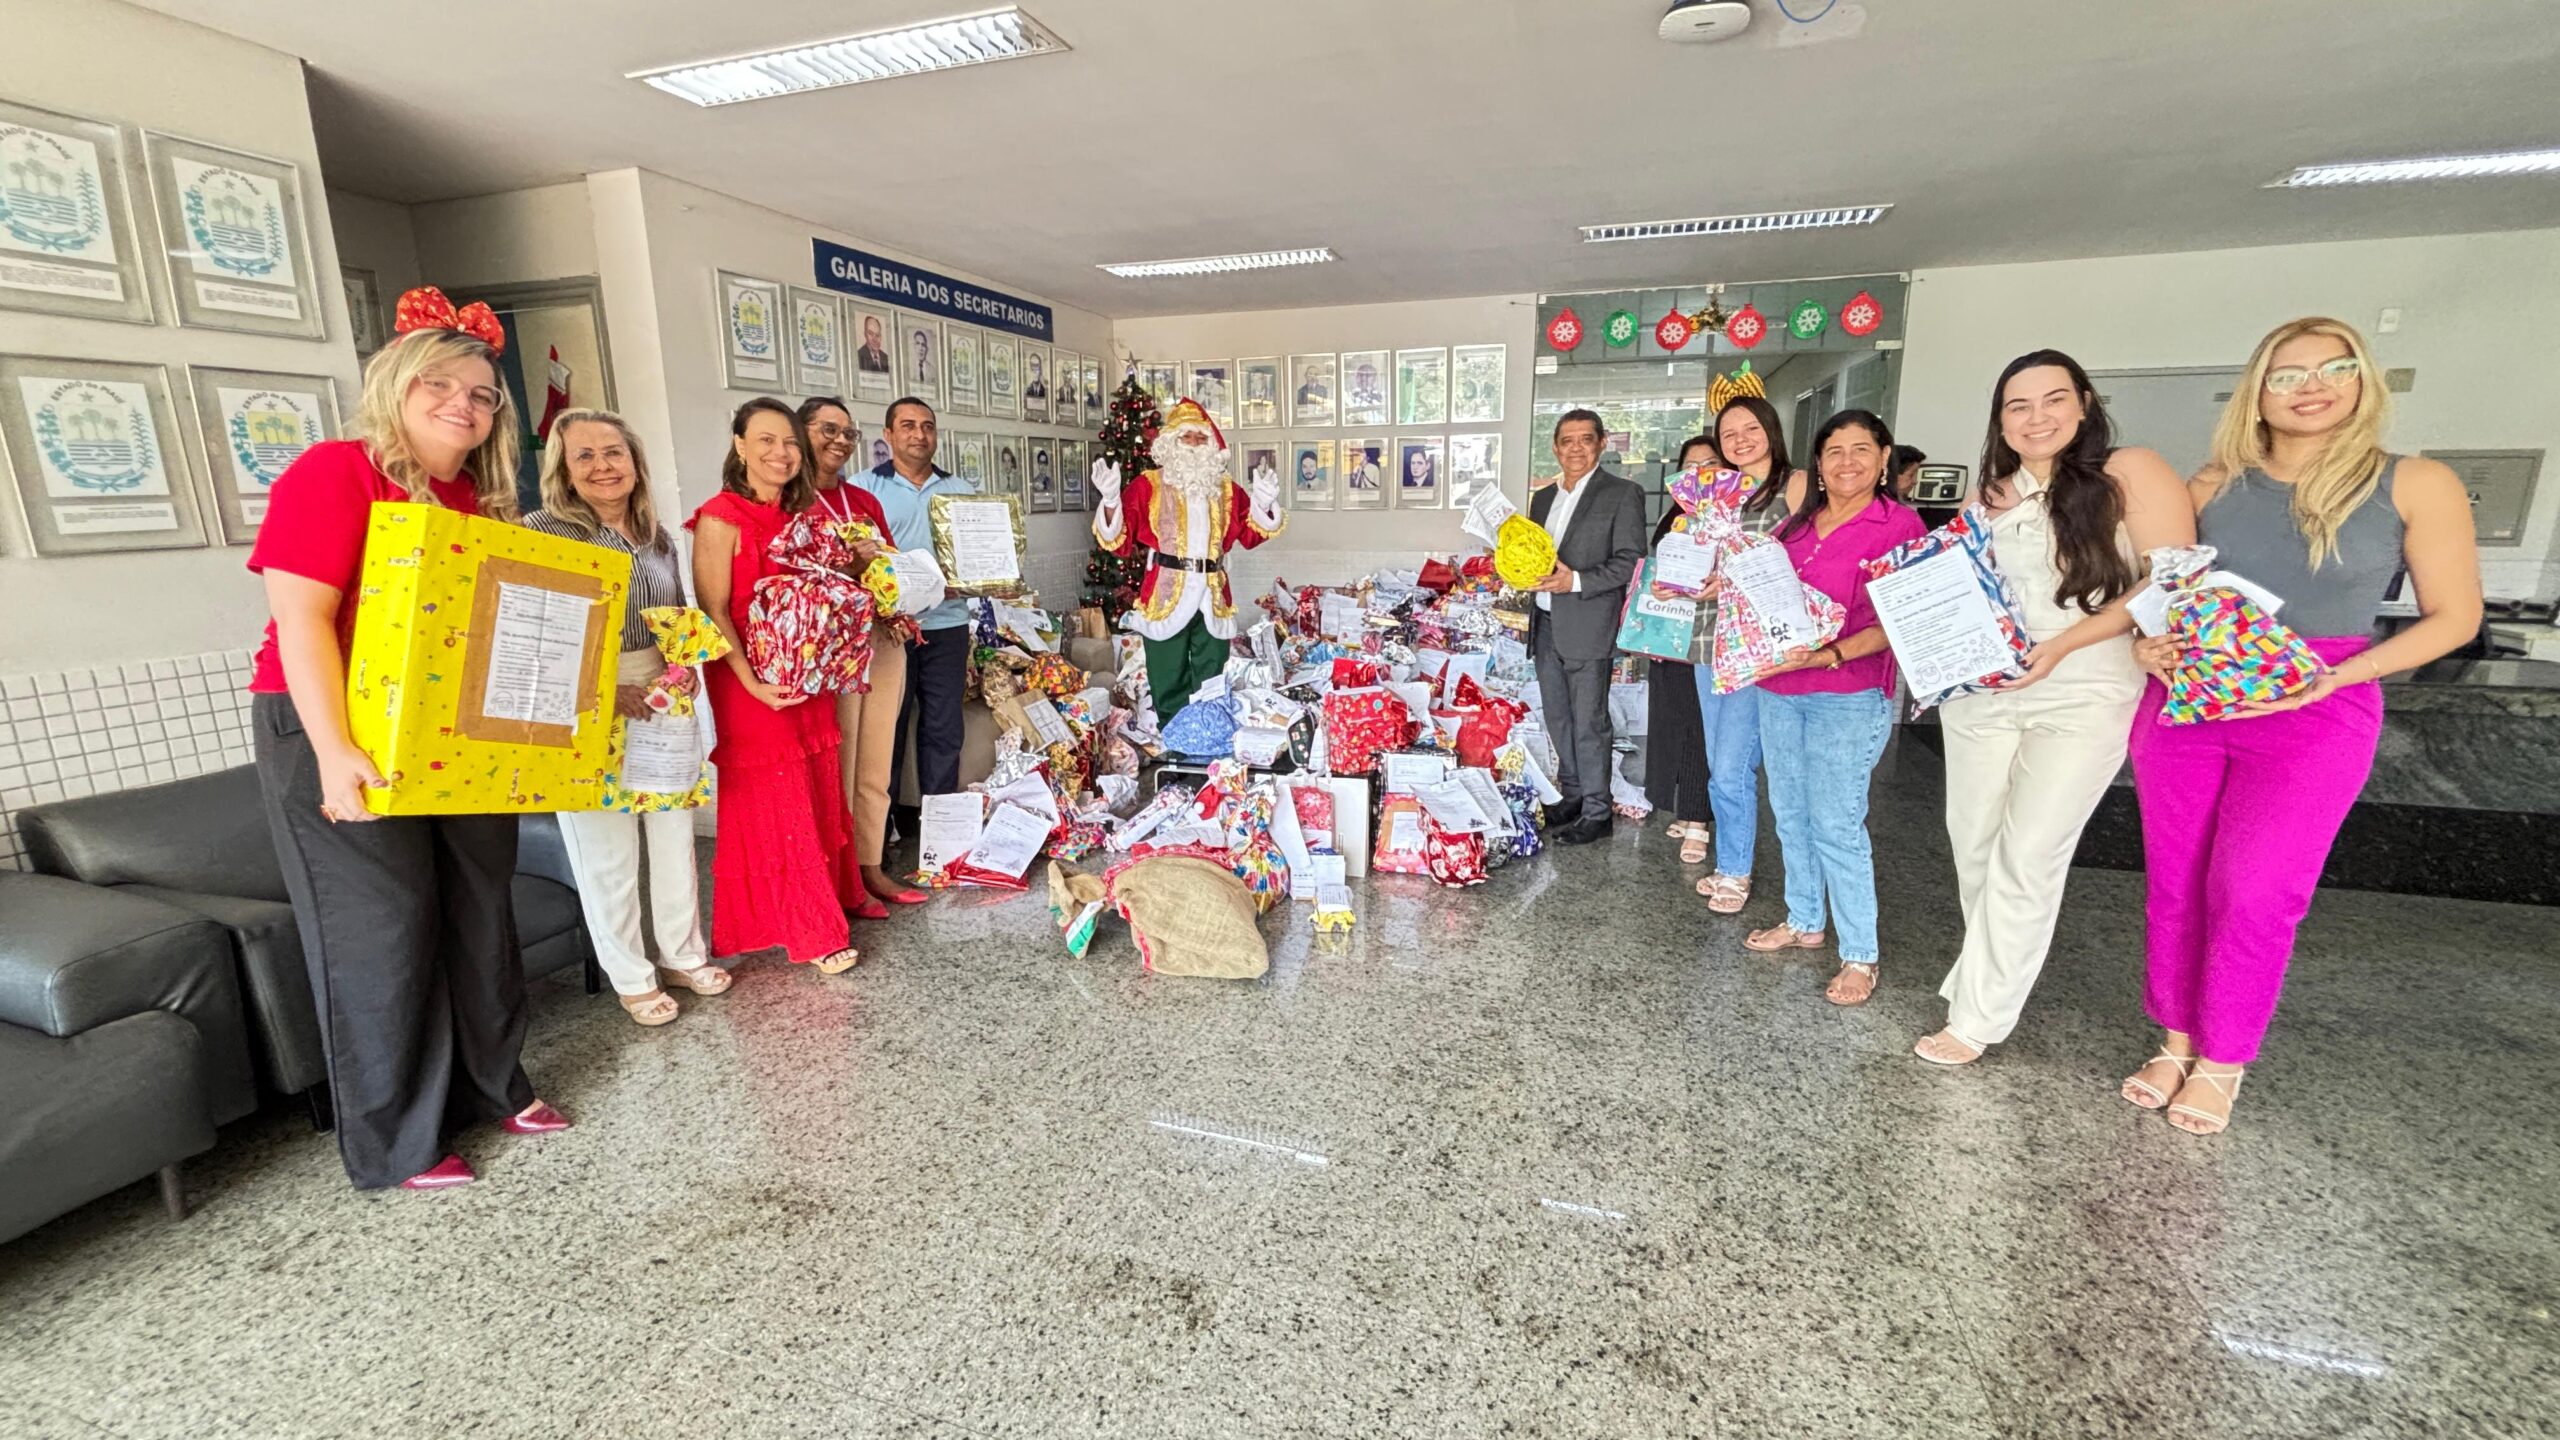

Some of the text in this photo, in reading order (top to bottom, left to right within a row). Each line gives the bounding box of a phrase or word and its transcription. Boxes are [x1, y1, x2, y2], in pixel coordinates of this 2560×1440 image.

[831, 256, 1045, 330] GALERIA DOS SECRETARIOS
[1646, 600, 1694, 617] Carinho
